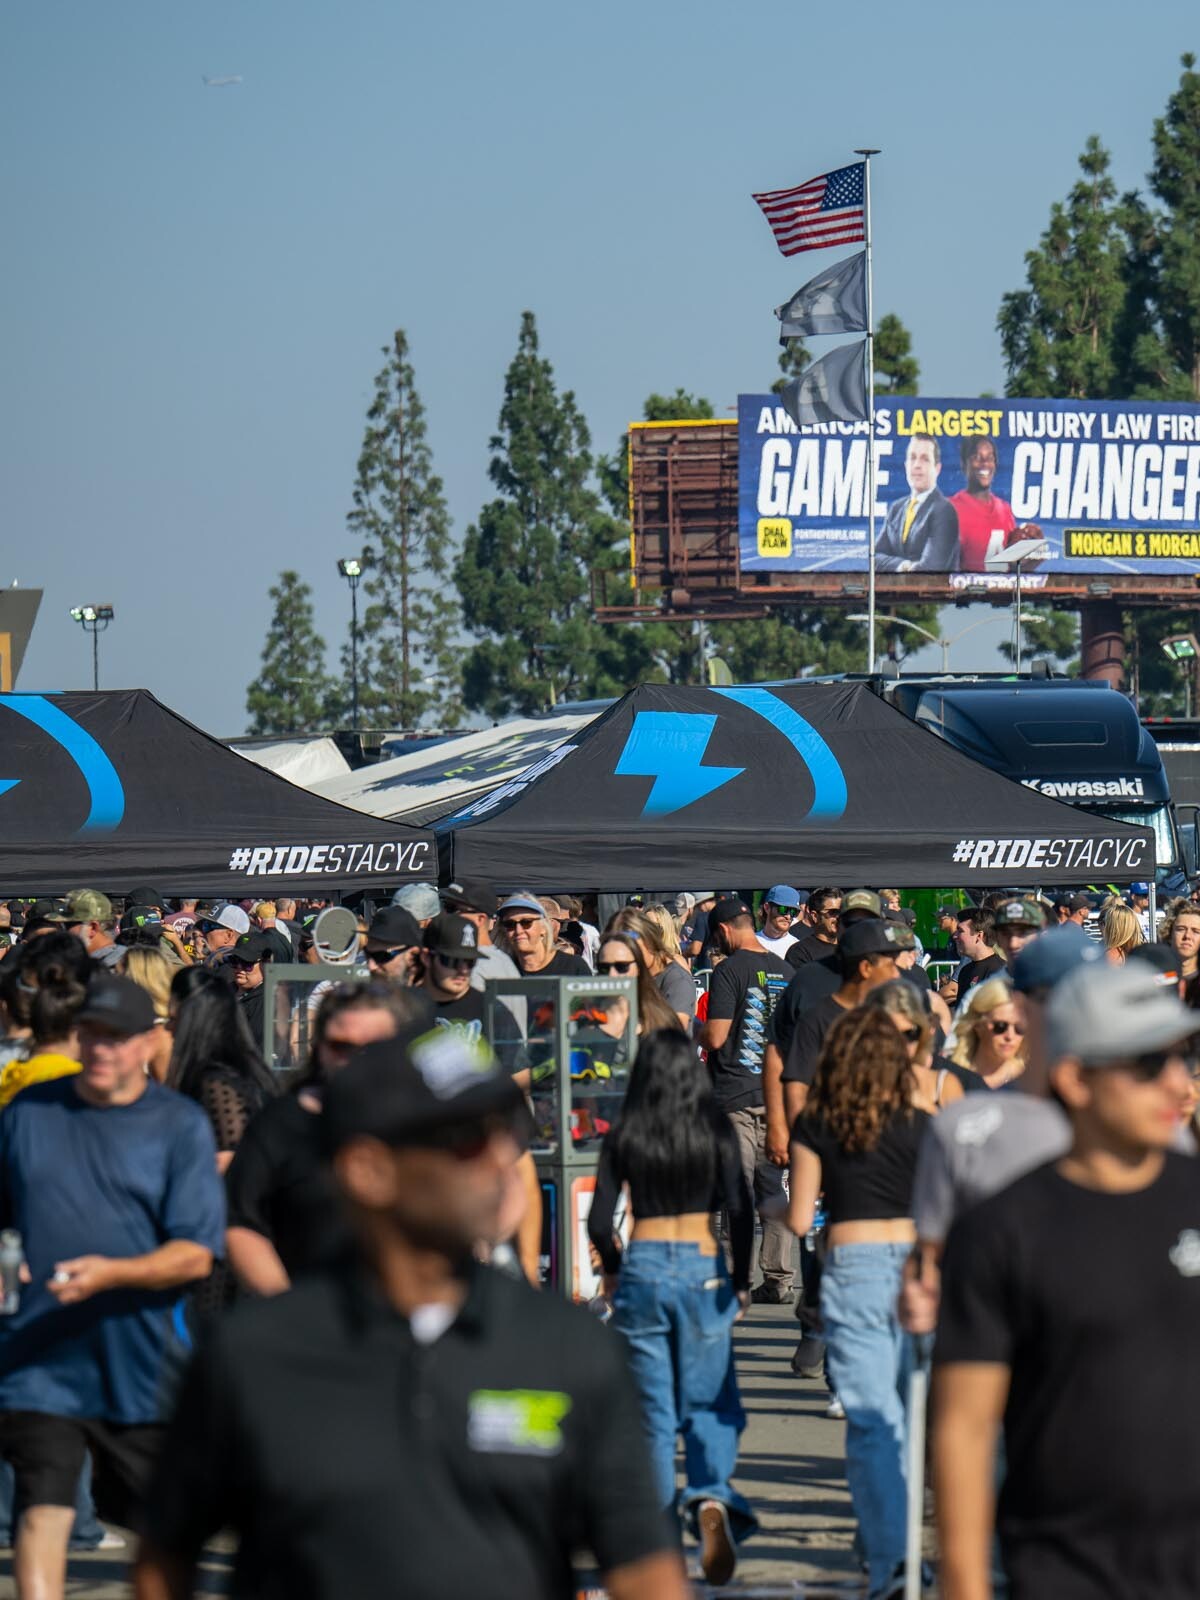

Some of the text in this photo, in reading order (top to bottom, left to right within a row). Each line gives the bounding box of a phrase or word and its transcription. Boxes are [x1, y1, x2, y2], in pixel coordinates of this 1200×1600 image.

[897, 409, 1003, 437] LARGEST
[1008, 411, 1096, 439] INJURY
[1101, 413, 1152, 440] LAW
[757, 438, 893, 517] GAME
[1070, 532, 1132, 555] MORGAN
[1135, 534, 1146, 556] &
[1021, 778, 1144, 797] Kawasaki
[229, 842, 429, 876] #RIDESTACYC
[952, 838, 1146, 869] #RIDESTACYC
